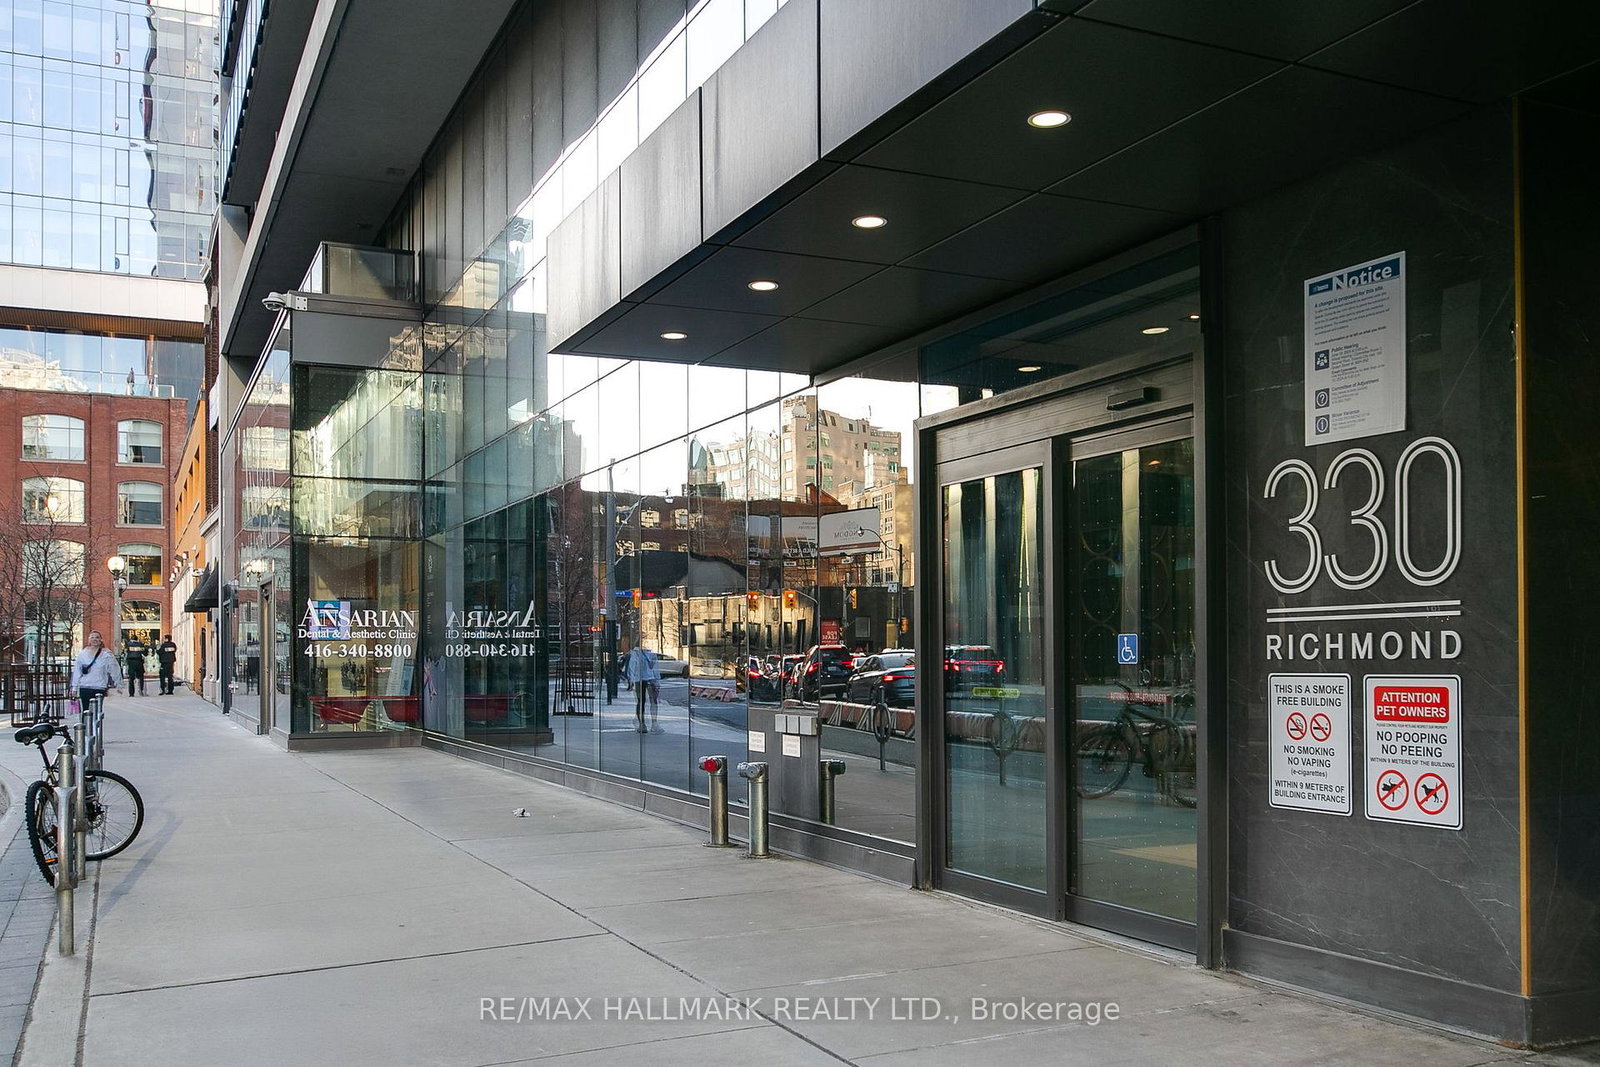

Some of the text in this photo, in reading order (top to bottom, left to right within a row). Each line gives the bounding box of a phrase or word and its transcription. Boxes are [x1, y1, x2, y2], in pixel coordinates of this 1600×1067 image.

[1332, 266, 1393, 290] Notice
[1264, 436, 1461, 594] 330
[298, 597, 418, 628] ANSARIAN
[298, 629, 417, 639] Dental & Aesthetic Clinic
[304, 643, 412, 658] 416-340-8800
[1266, 630, 1462, 660] RICHMOND
[1274, 684, 1344, 695] THIS IS A SMOKE
[1277, 696, 1342, 707] FREE BUILDING
[1381, 692, 1440, 703] ATTENTION
[1376, 705, 1447, 718] PET OWNERS
[1376, 731, 1448, 745] NO POOPING
[1284, 745, 1335, 757] NO SMOKING
[1381, 744, 1443, 758] NO PEEING
[1287, 757, 1331, 768] NO VAPING
[1291, 768, 1328, 779] (e-cigarettes)
[1274, 779, 1345, 793] WITHIN 9 METERS OF
[1274, 789, 1346, 804] BUILDING ENTRANCE
